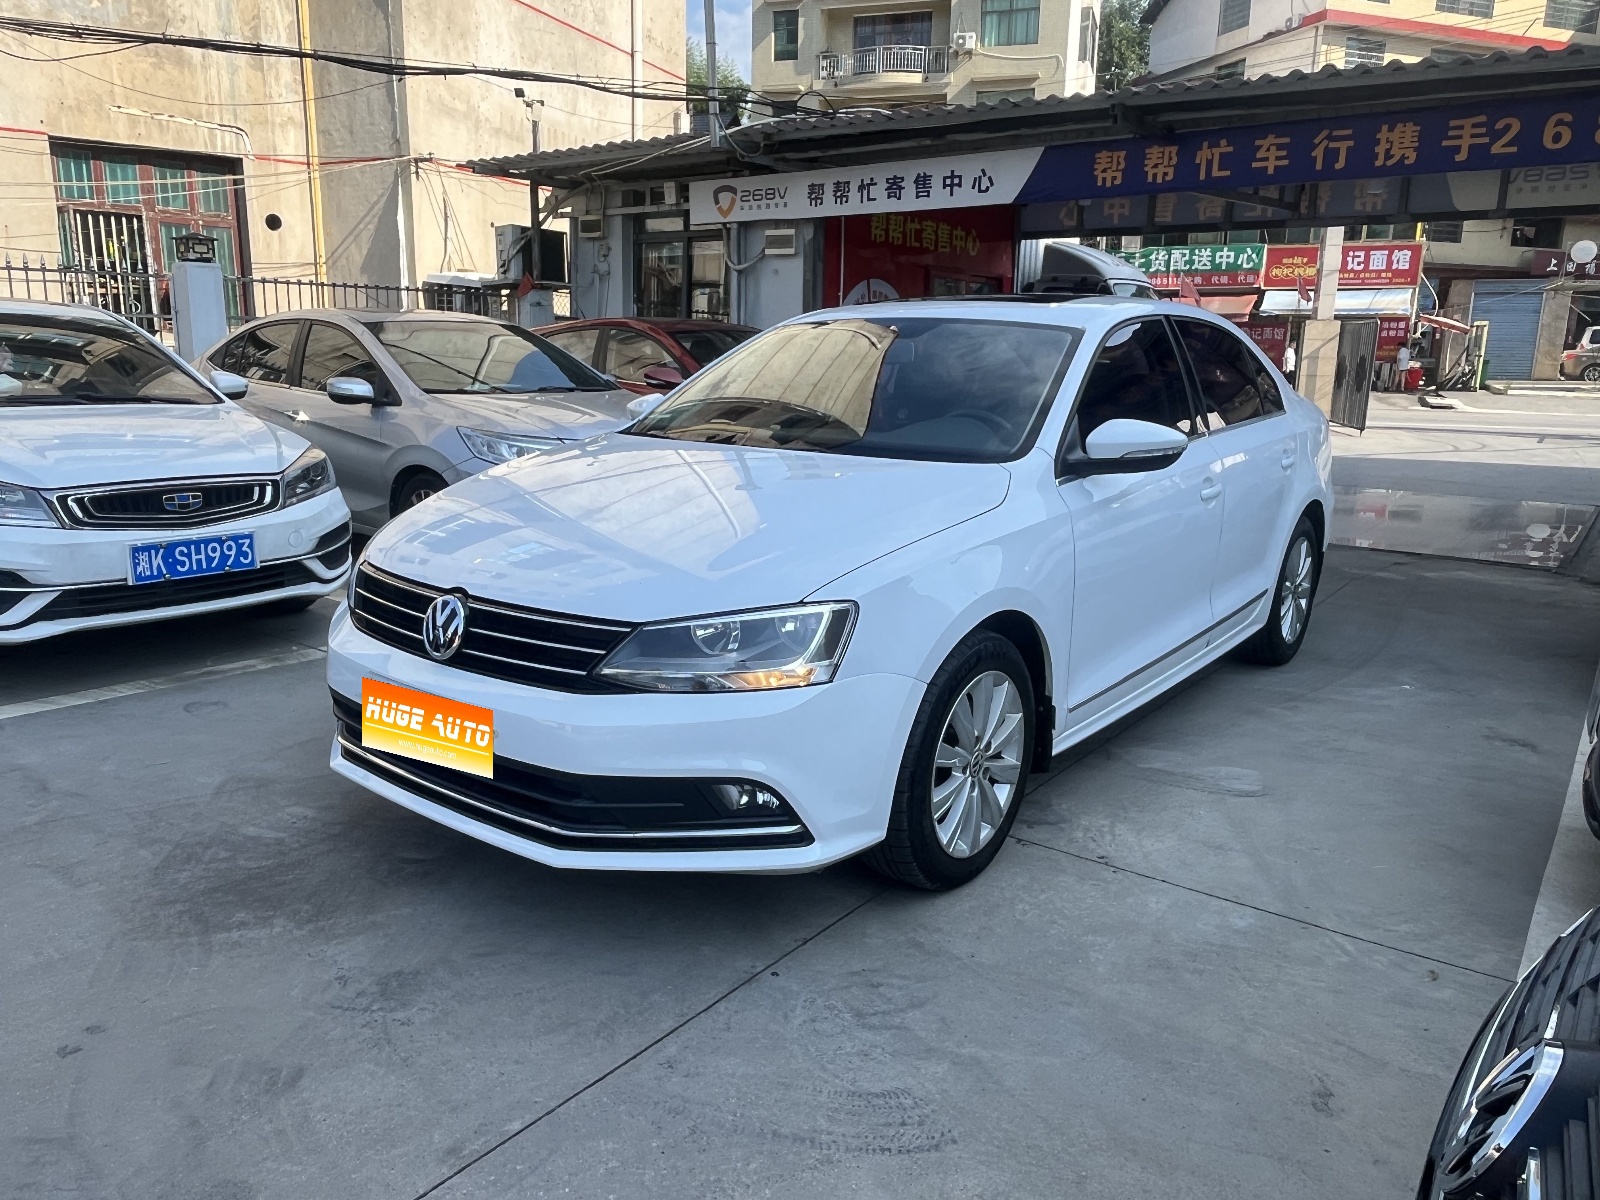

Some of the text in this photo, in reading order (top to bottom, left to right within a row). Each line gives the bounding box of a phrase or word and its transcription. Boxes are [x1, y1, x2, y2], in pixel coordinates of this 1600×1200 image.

[1093, 112, 1600, 188] 帮帮忙车行携手26
[740, 186, 788, 202] 268V
[807, 168, 995, 207] 帮帮忙寄售中心
[870, 213, 980, 256] 帮帮忙寄售中心
